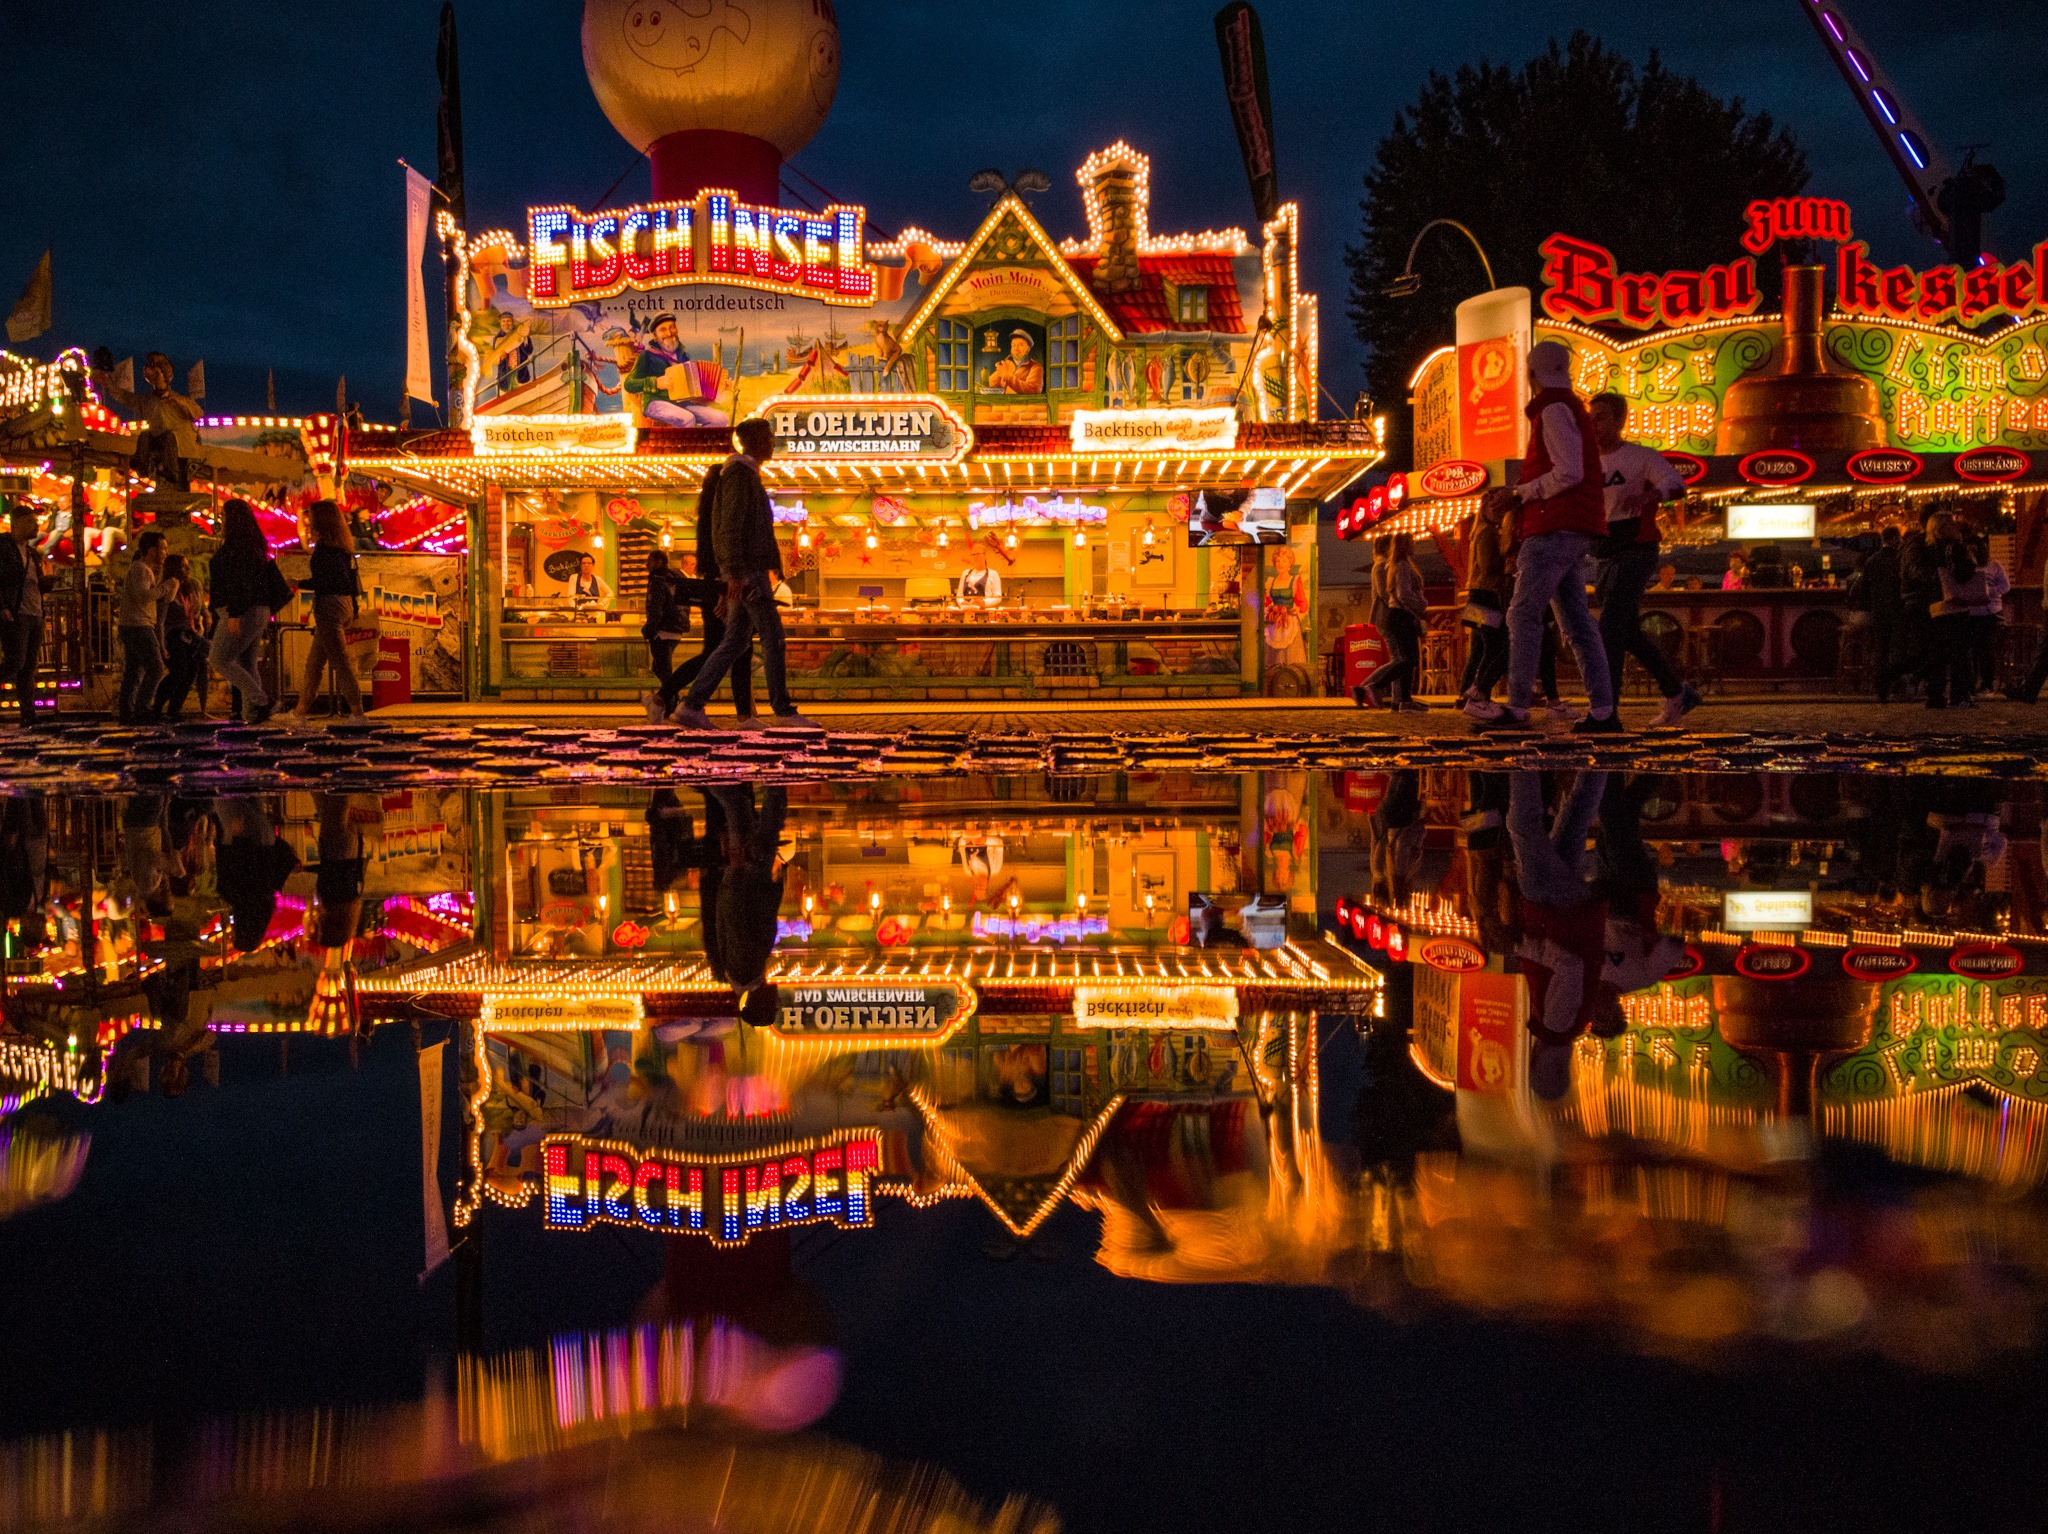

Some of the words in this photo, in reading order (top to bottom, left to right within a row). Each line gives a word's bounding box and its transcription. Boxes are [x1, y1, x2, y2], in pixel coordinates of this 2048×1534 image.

[1744, 198, 1850, 251] zum
[534, 206, 696, 298] FISCH
[708, 194, 875, 297] INSEL
[970, 273, 1003, 289] Moin
[1543, 234, 1757, 322] Brau
[674, 294, 785, 311] norddeutsch
[1575, 348, 1716, 396] Bier
[775, 411, 932, 436] H.OELTJEN
[1084, 421, 1163, 438] Backfisch
[485, 428, 554, 442] Brötchen
[787, 440, 816, 452] BAD
[820, 440, 921, 453] ZWISCHENAHN
[1858, 459, 1912, 473] WHISKY
[540, 526, 578, 537] Backfisch
[374, 587, 442, 626] INSEL
